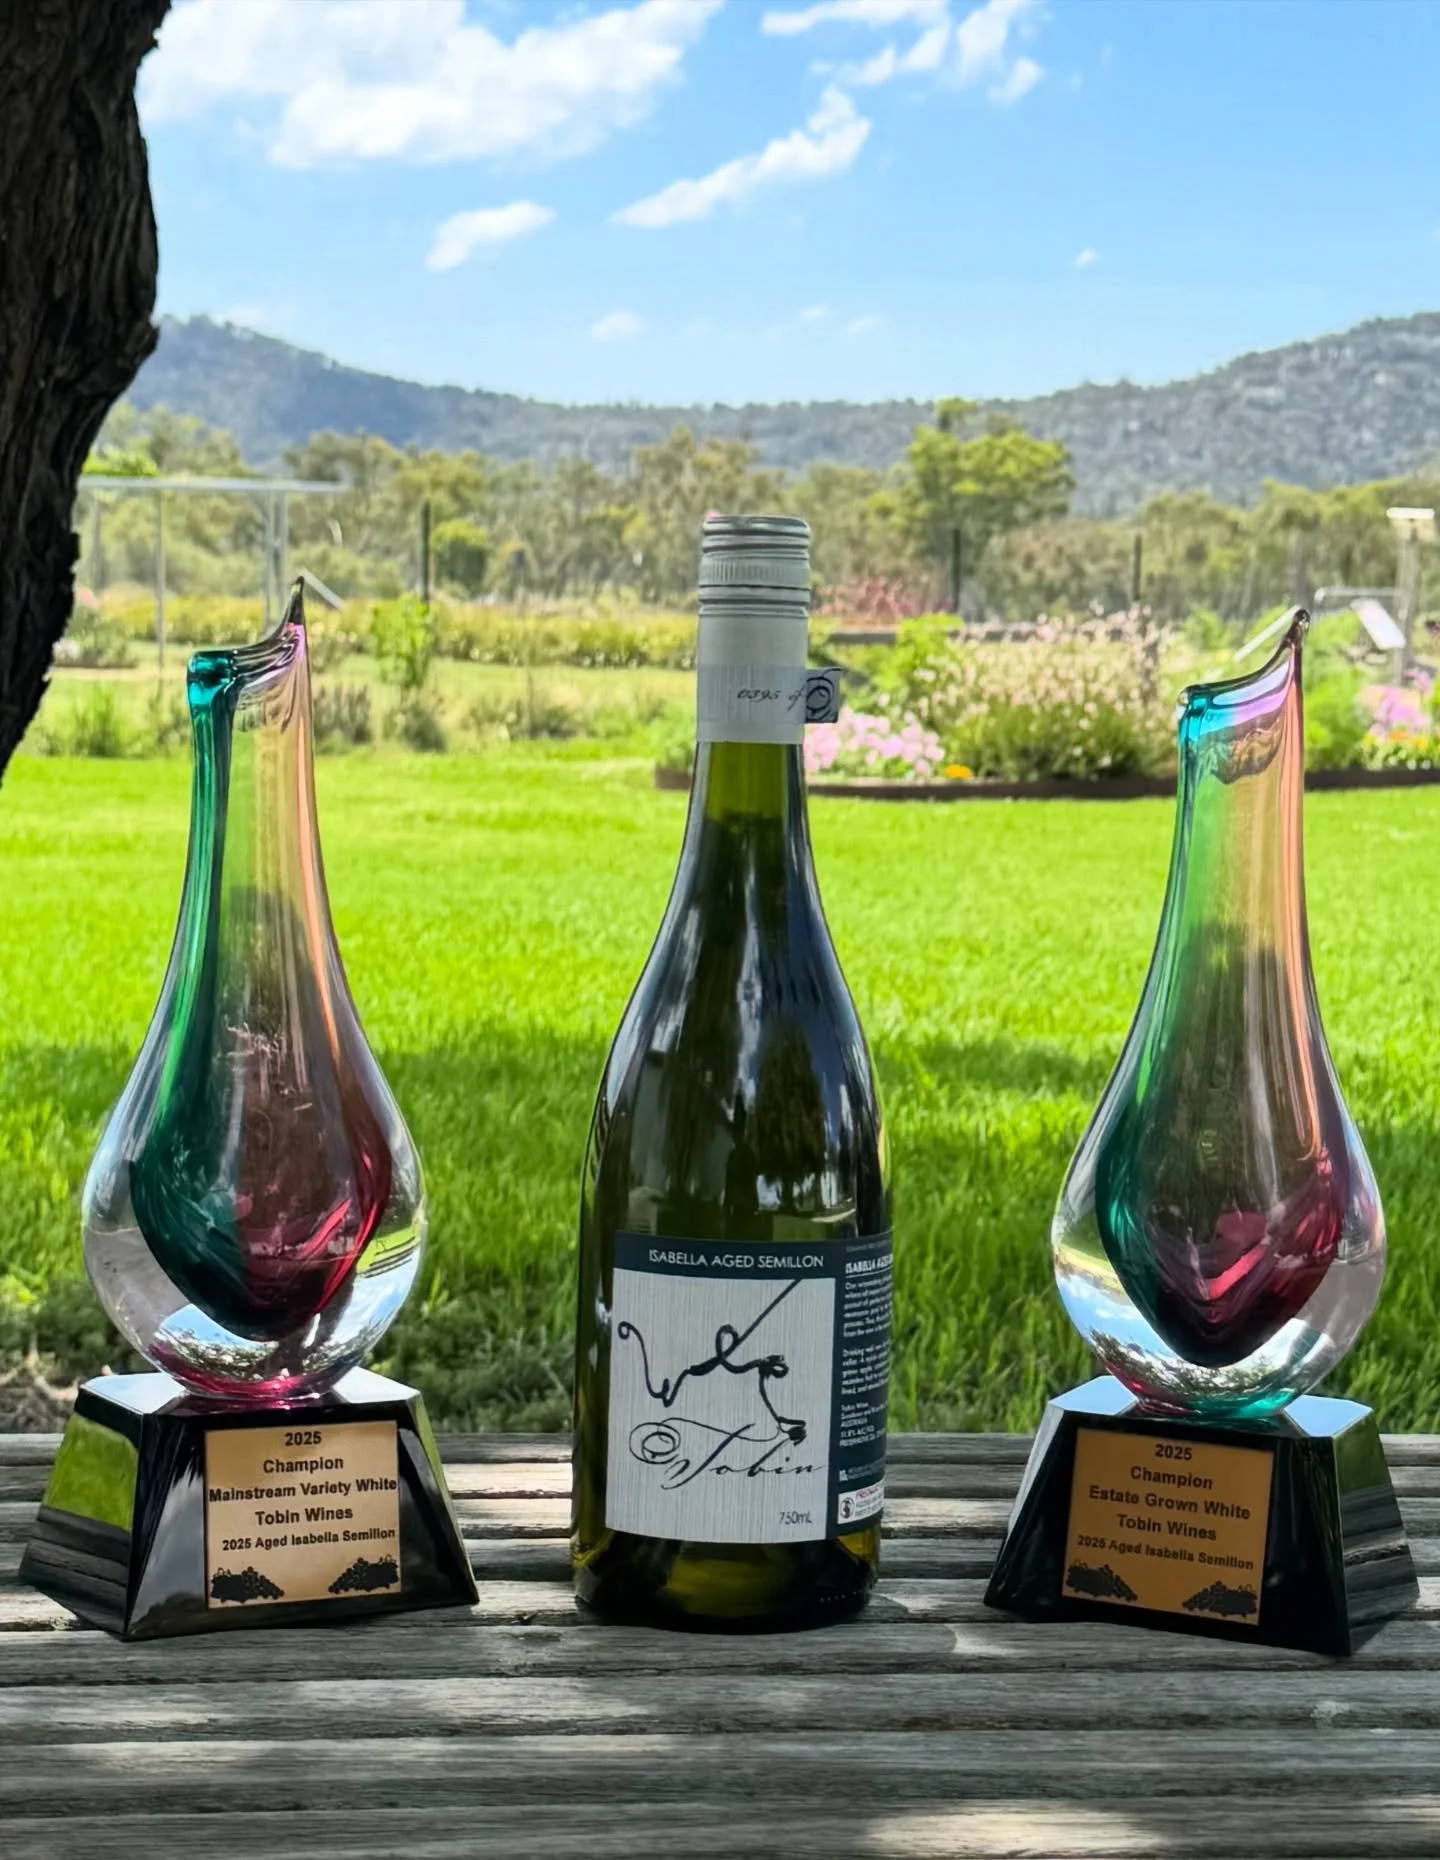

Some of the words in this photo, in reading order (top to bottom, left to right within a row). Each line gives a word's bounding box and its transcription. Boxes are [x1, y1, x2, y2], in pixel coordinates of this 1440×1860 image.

[649, 1249, 708, 1267] ISABELLA
[711, 1254, 754, 1268] AGED
[757, 1255, 824, 1269] SEMILLON
[285, 1431, 322, 1446] 2025
[1155, 1443, 1193, 1461] 2025
[263, 1456, 344, 1474] Champion
[1130, 1466, 1213, 1490] Champion
[209, 1484, 296, 1502] Mainstream
[300, 1481, 351, 1496] Variety
[356, 1478, 397, 1492] White
[1088, 1485, 1140, 1504] Estate
[1145, 1493, 1198, 1512] Grown
[1204, 1501, 1251, 1519] White
[255, 1510, 300, 1525] Tobin
[305, 1507, 353, 1522] Wines
[1117, 1514, 1161, 1533] Tobin
[1167, 1520, 1217, 1541] Wines
[222, 1537, 251, 1551] 2025
[255, 1535, 287, 1550] Aged
[291, 1531, 339, 1546] Isabella
[342, 1528, 396, 1541] Semillon
[1077, 1535, 1106, 1548] 2025
[1108, 1539, 1142, 1555] Aged
[1146, 1545, 1194, 1562] Isabella
[1198, 1552, 1254, 1570] Semillon
